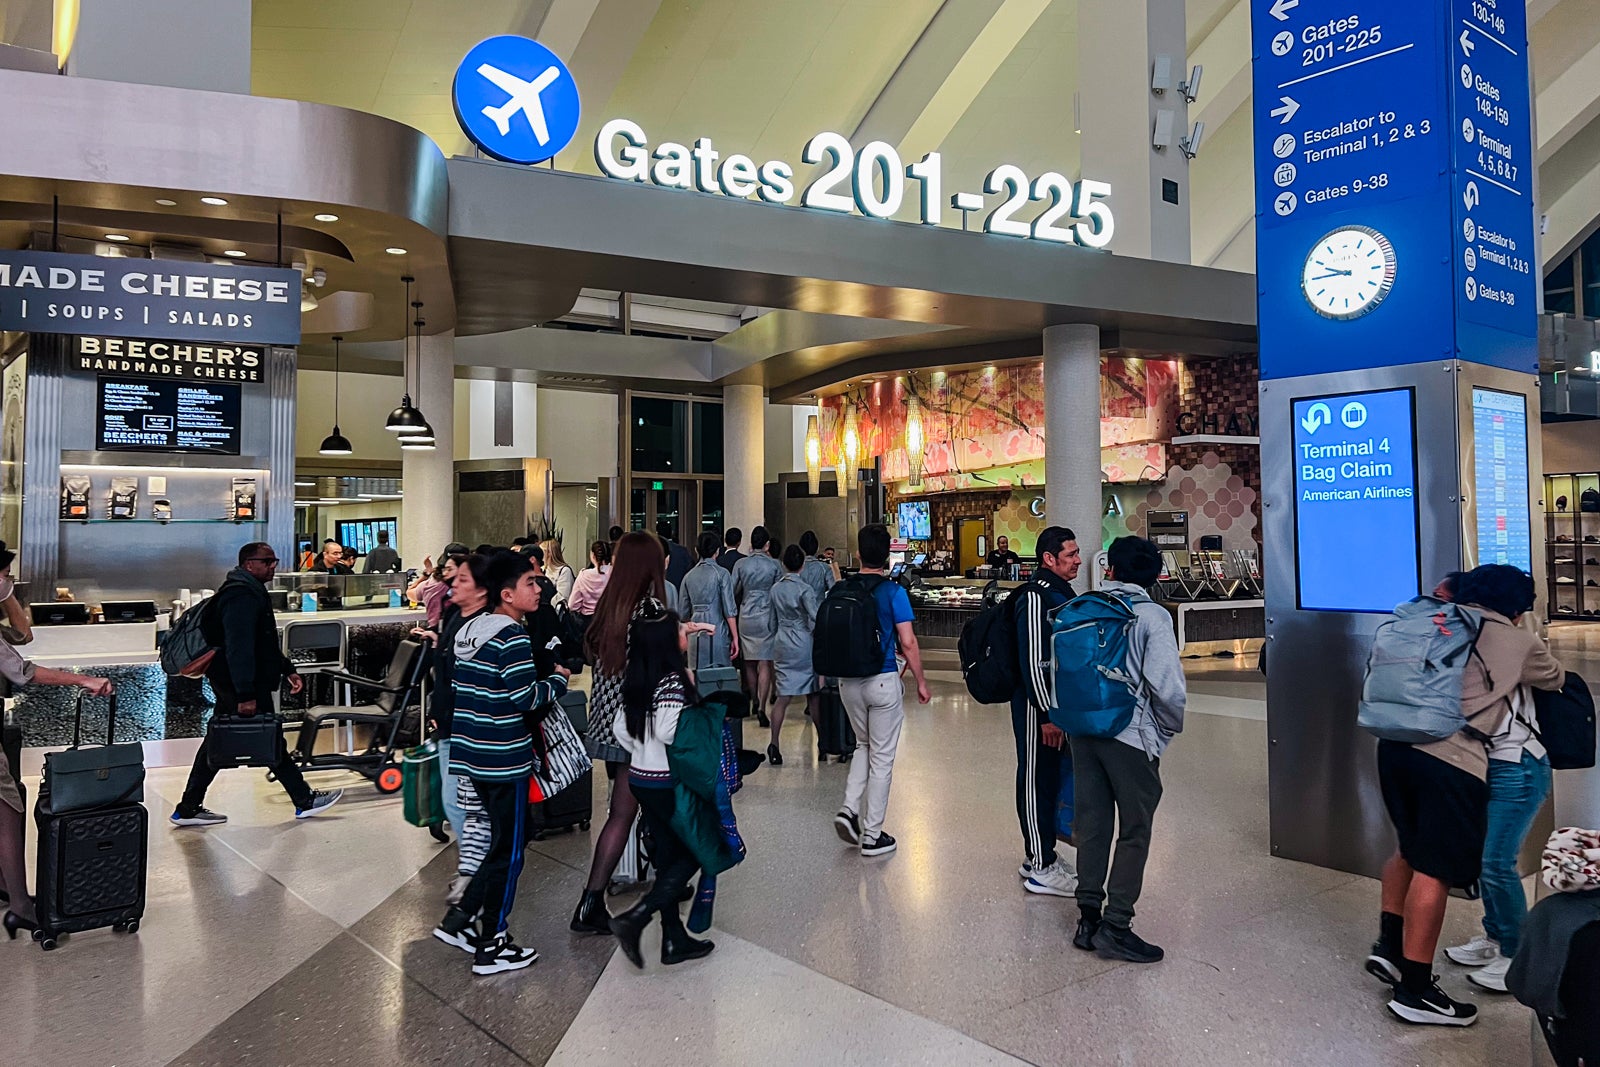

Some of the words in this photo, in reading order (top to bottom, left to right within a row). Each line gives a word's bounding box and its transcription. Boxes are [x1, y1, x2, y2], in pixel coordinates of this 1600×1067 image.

[1302, 14, 1359, 45] Gates
[1472, 1, 1505, 35] 130-146
[1302, 25, 1382, 67] 201-225
[1475, 74, 1500, 102] Gates
[1476, 96, 1509, 126] 148-159
[1303, 117, 1374, 145] Escalator
[1379, 111, 1396, 126] to
[1304, 135, 1367, 164] Terminal
[1371, 132, 1384, 148] 1,
[1389, 128, 1399, 143] 2
[1403, 124, 1416, 139] &
[1420, 119, 1431, 134] 3
[1477, 128, 1512, 160] Terminal
[1478, 151, 1487, 171] 4,
[1488, 155, 1496, 175] 5,
[1497, 159, 1504, 176] 6
[1504, 162, 1512, 179] &
[1511, 166, 1518, 182] 7
[594, 118, 794, 203] Gates
[801, 131, 1115, 248] 201-225
[1304, 180, 1349, 204] Gates
[1353, 173, 1389, 193] 9-38
[1478, 225, 1508, 248] Escalator
[1509, 237, 1516, 251] to
[1478, 244, 1507, 266] Terminal
[1513, 257, 1519, 271] 2
[1519, 259, 1524, 273] &
[1523, 261, 1529, 274] 3
[120, 272, 289, 304] CHEESE
[1480, 283, 1500, 302] Gates
[1499, 289, 1515, 306] 9-38
[48, 303, 124, 321] SOUPS
[169, 310, 253, 328] SALADS
[80, 336, 259, 367] BEECHER'S
[81, 358, 183, 375] HANDMADE
[194, 366, 257, 380] CHEESE
[103, 431, 168, 441] BEECHER'S
[1300, 438, 1374, 459] Terminal
[1378, 437, 1391, 454] 4
[1302, 464, 1336, 483] Bag
[1340, 461, 1392, 479] Claim
[1302, 488, 1360, 501] American
[1363, 486, 1413, 499] Airlines
